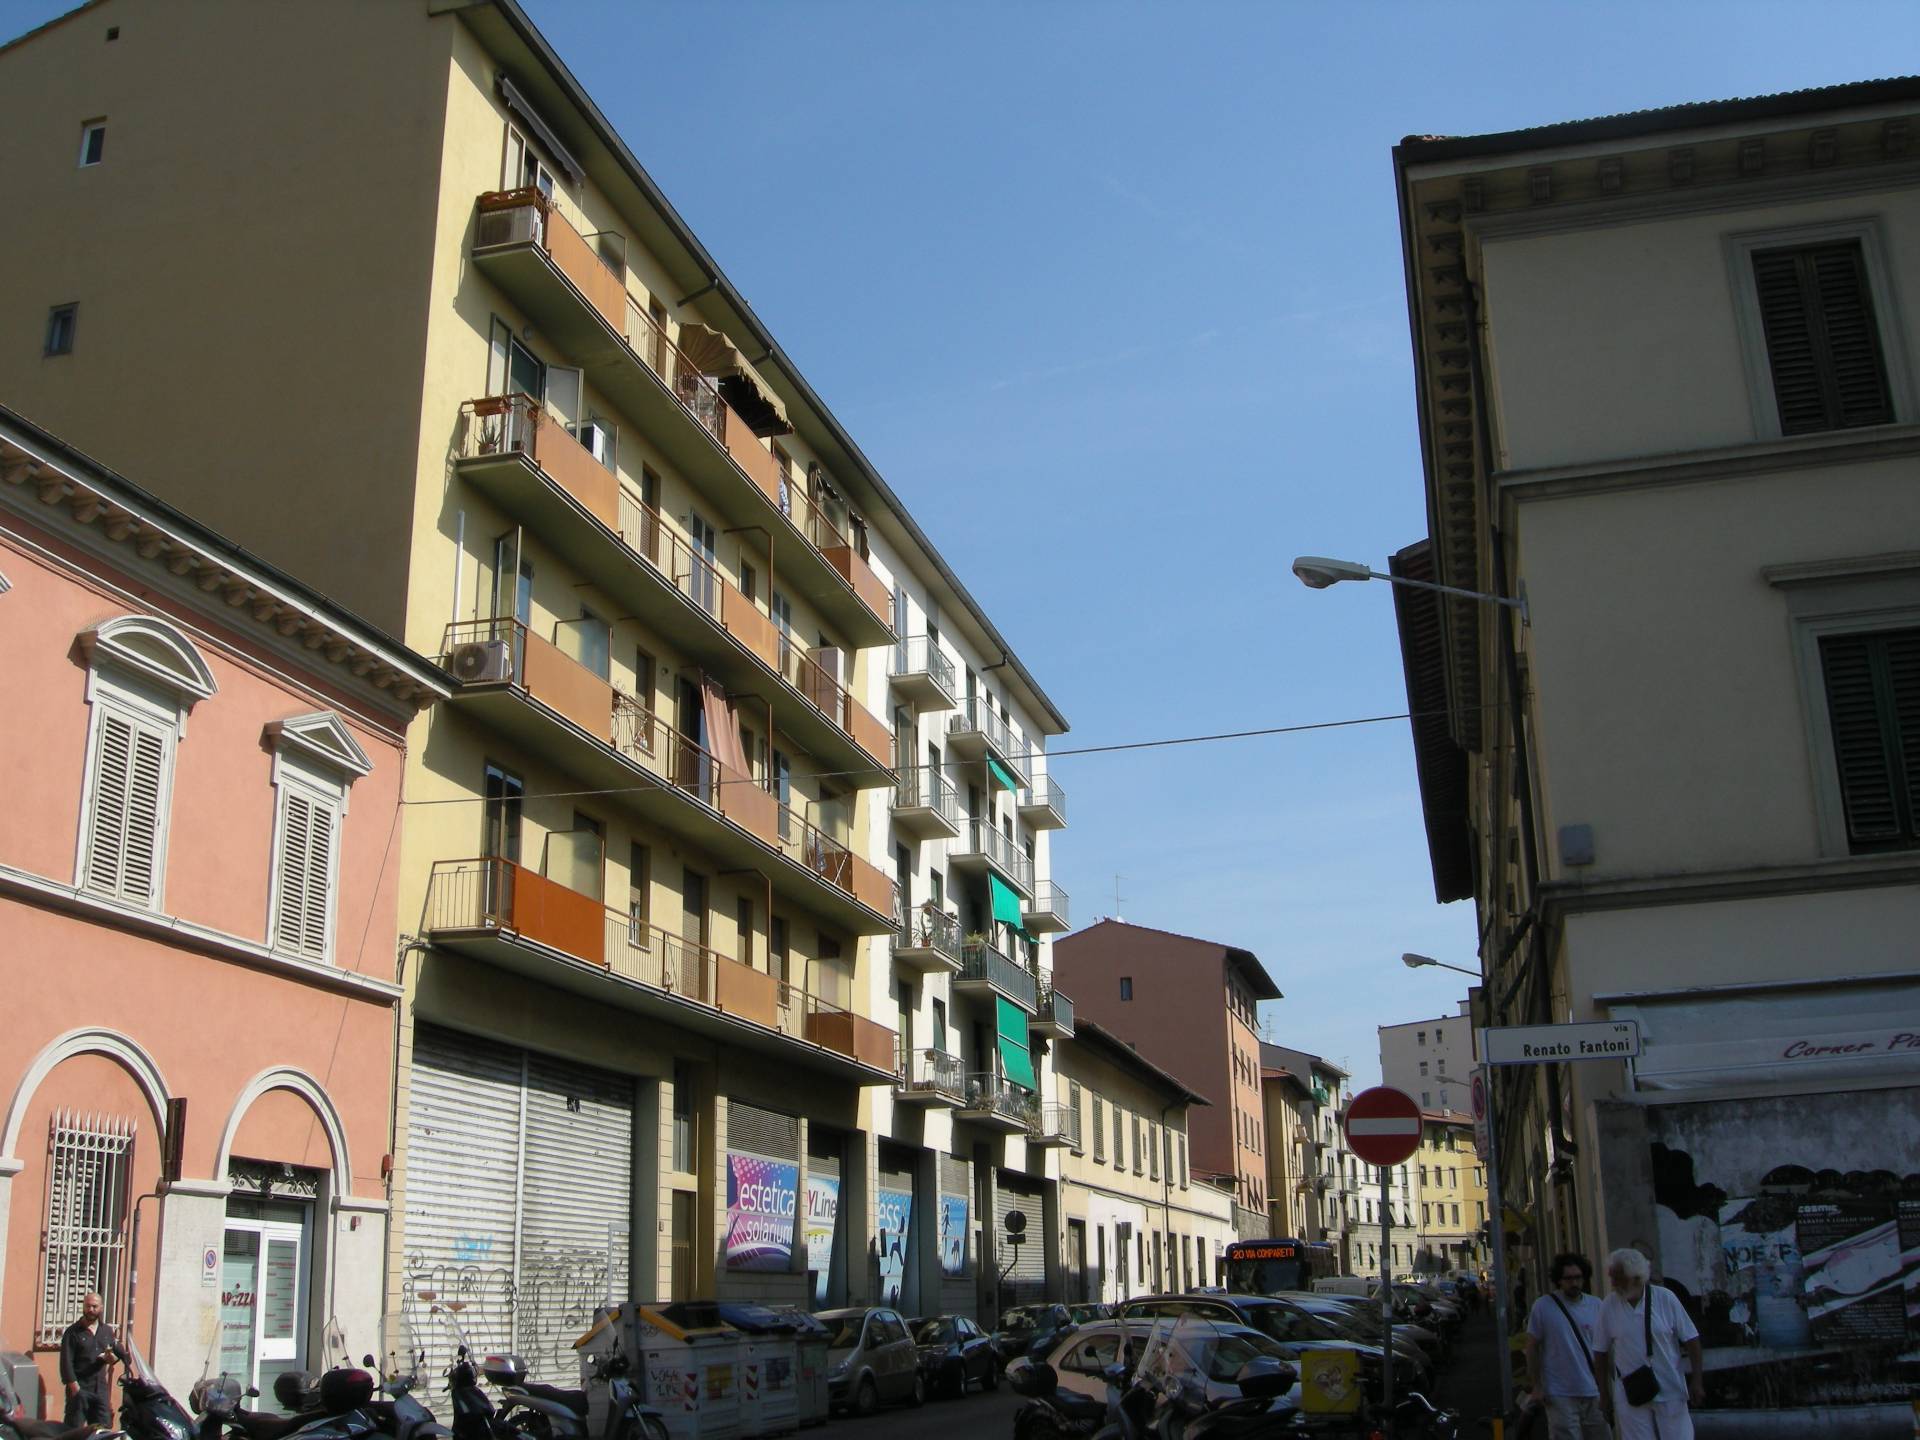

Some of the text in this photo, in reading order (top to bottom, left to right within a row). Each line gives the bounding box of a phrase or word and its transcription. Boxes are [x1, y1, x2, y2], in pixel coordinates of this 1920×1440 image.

[1523, 1038, 1629, 1057] Renato Fantoni
[1783, 1041, 1874, 1058] Corner
[739, 1178, 796, 1216] estetica
[746, 1215, 793, 1246] solarium
[1233, 1247, 1295, 1260] 20 VIA COMPARETTI
